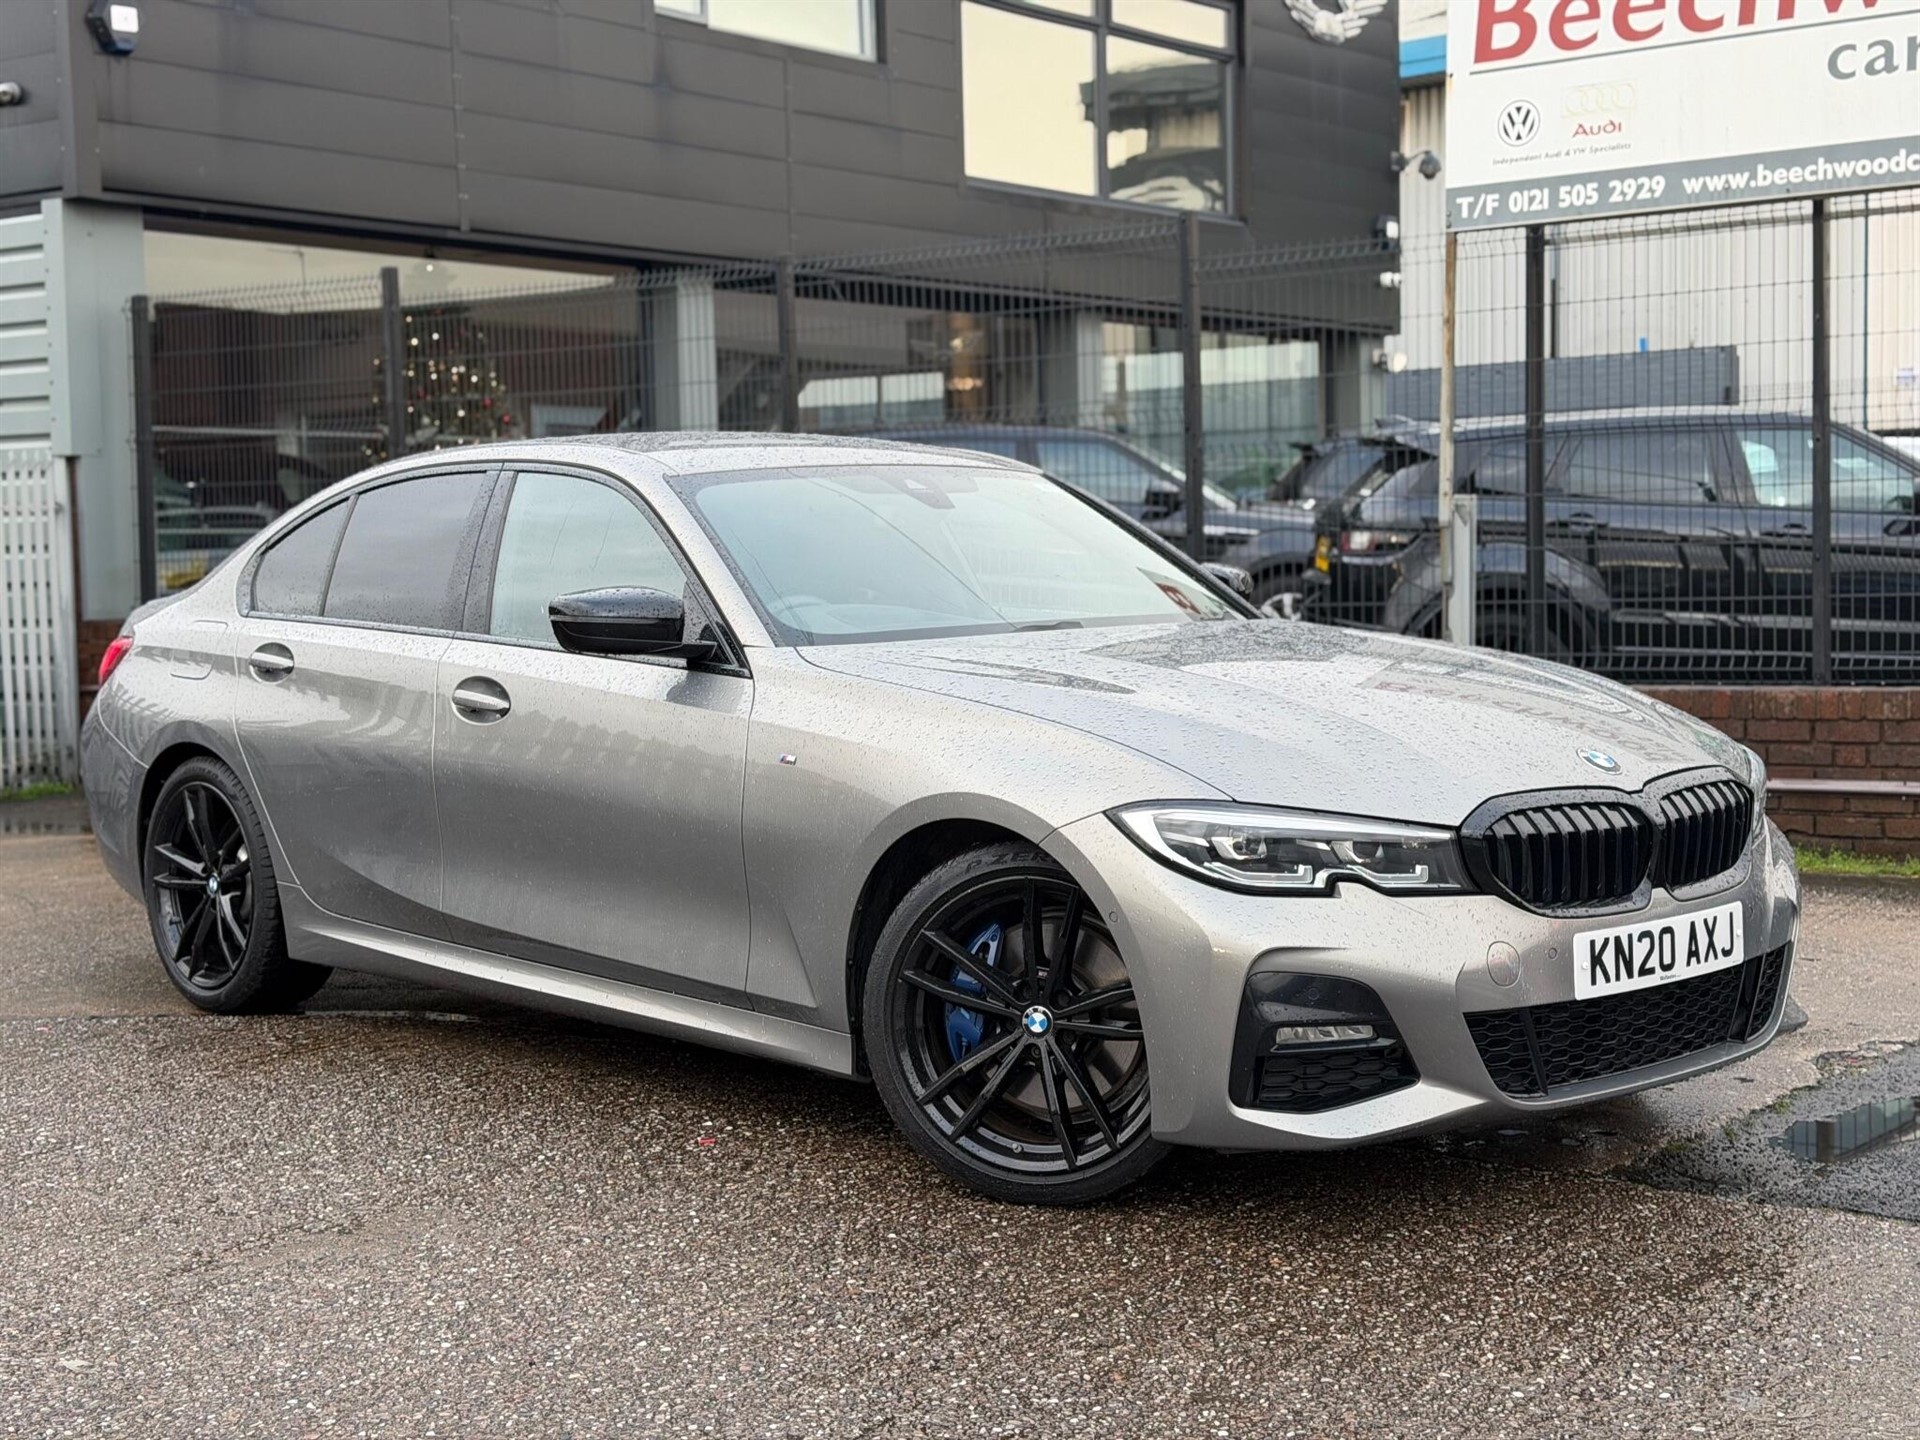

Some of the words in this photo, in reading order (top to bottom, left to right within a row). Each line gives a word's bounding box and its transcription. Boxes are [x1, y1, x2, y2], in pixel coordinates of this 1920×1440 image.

[1474, 0, 1878, 63] Beec
[1571, 119, 1622, 138] Audi
[1543, 150, 1562, 160] Audi
[1589, 142, 1631, 155] Specialists
[1456, 193, 1500, 219] T/F
[1508, 187, 1549, 213] 0121
[1558, 182, 1599, 208] 505
[1608, 175, 1666, 203] 2929
[1589, 925, 1676, 987] KN20
[1686, 911, 1734, 968] AXJ
